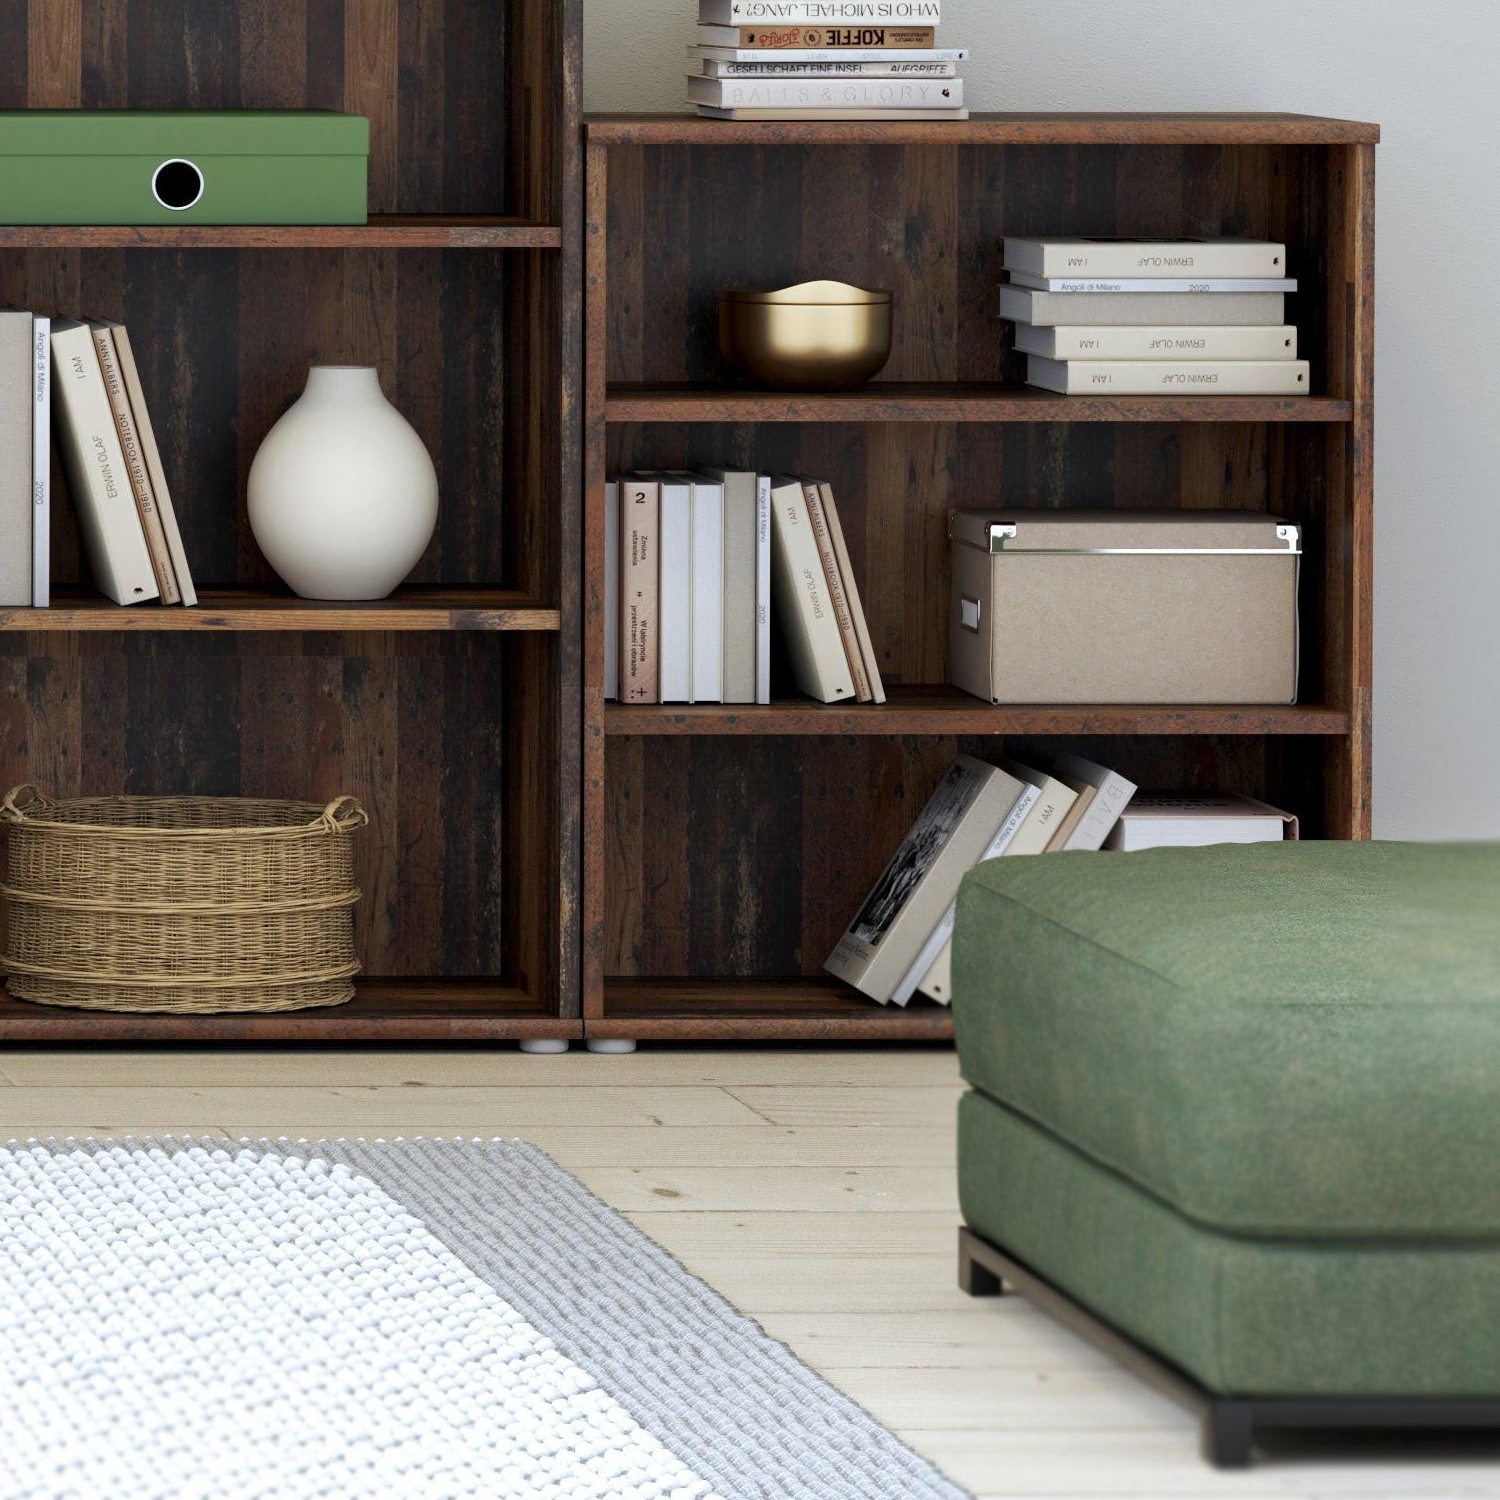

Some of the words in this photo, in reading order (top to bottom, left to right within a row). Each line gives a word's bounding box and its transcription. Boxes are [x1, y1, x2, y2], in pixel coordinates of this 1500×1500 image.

[747, 3, 798, 16] JANG?
[801, 3, 875, 16] MICHAEL
[878, 3, 892, 16] IS
[896, 3, 939, 16] WHO
[827, 30, 884, 45] KOFFIE
[1068, 258, 1083, 266] AM
[1137, 258, 1162, 267] OLAF
[1164, 258, 1194, 266] ERWIN
[1061, 284, 1085, 292] Angoli
[1096, 283, 1120, 291] Milano
[1189, 284, 1209, 292] 2020
[37, 331, 45, 360] Angoli
[1079, 340, 1094, 348] AM
[1149, 340, 1173, 348] OLAF
[1175, 339, 1205, 348] ERWIN
[98, 338, 112, 363] ANNI
[37, 362, 45, 370] di
[72, 356, 84, 372] AM
[104, 364, 120, 395] ALBERS
[1092, 375, 1107, 383] AM
[1162, 375, 1186, 383] OLAF
[1188, 374, 1218, 382] ERWIN
[37, 372, 45, 402] Milano
[118, 413, 137, 463] NOTEBOOK
[92, 435, 108, 464] OLAF
[101, 464, 117, 499] ERWIN
[36, 481, 44, 504] 2020
[636, 493, 645, 503] 2
[787, 507, 797, 520] AM
[808, 492, 818, 512] ANNI
[813, 512, 825, 537] ALBERS
[824, 551, 840, 592] NOTEBOOK
[804, 569, 815, 591] OLAF
[811, 592, 823, 619] ERWIN
[641, 620, 647, 628] W
[1017, 795, 1032, 818] Angoli
